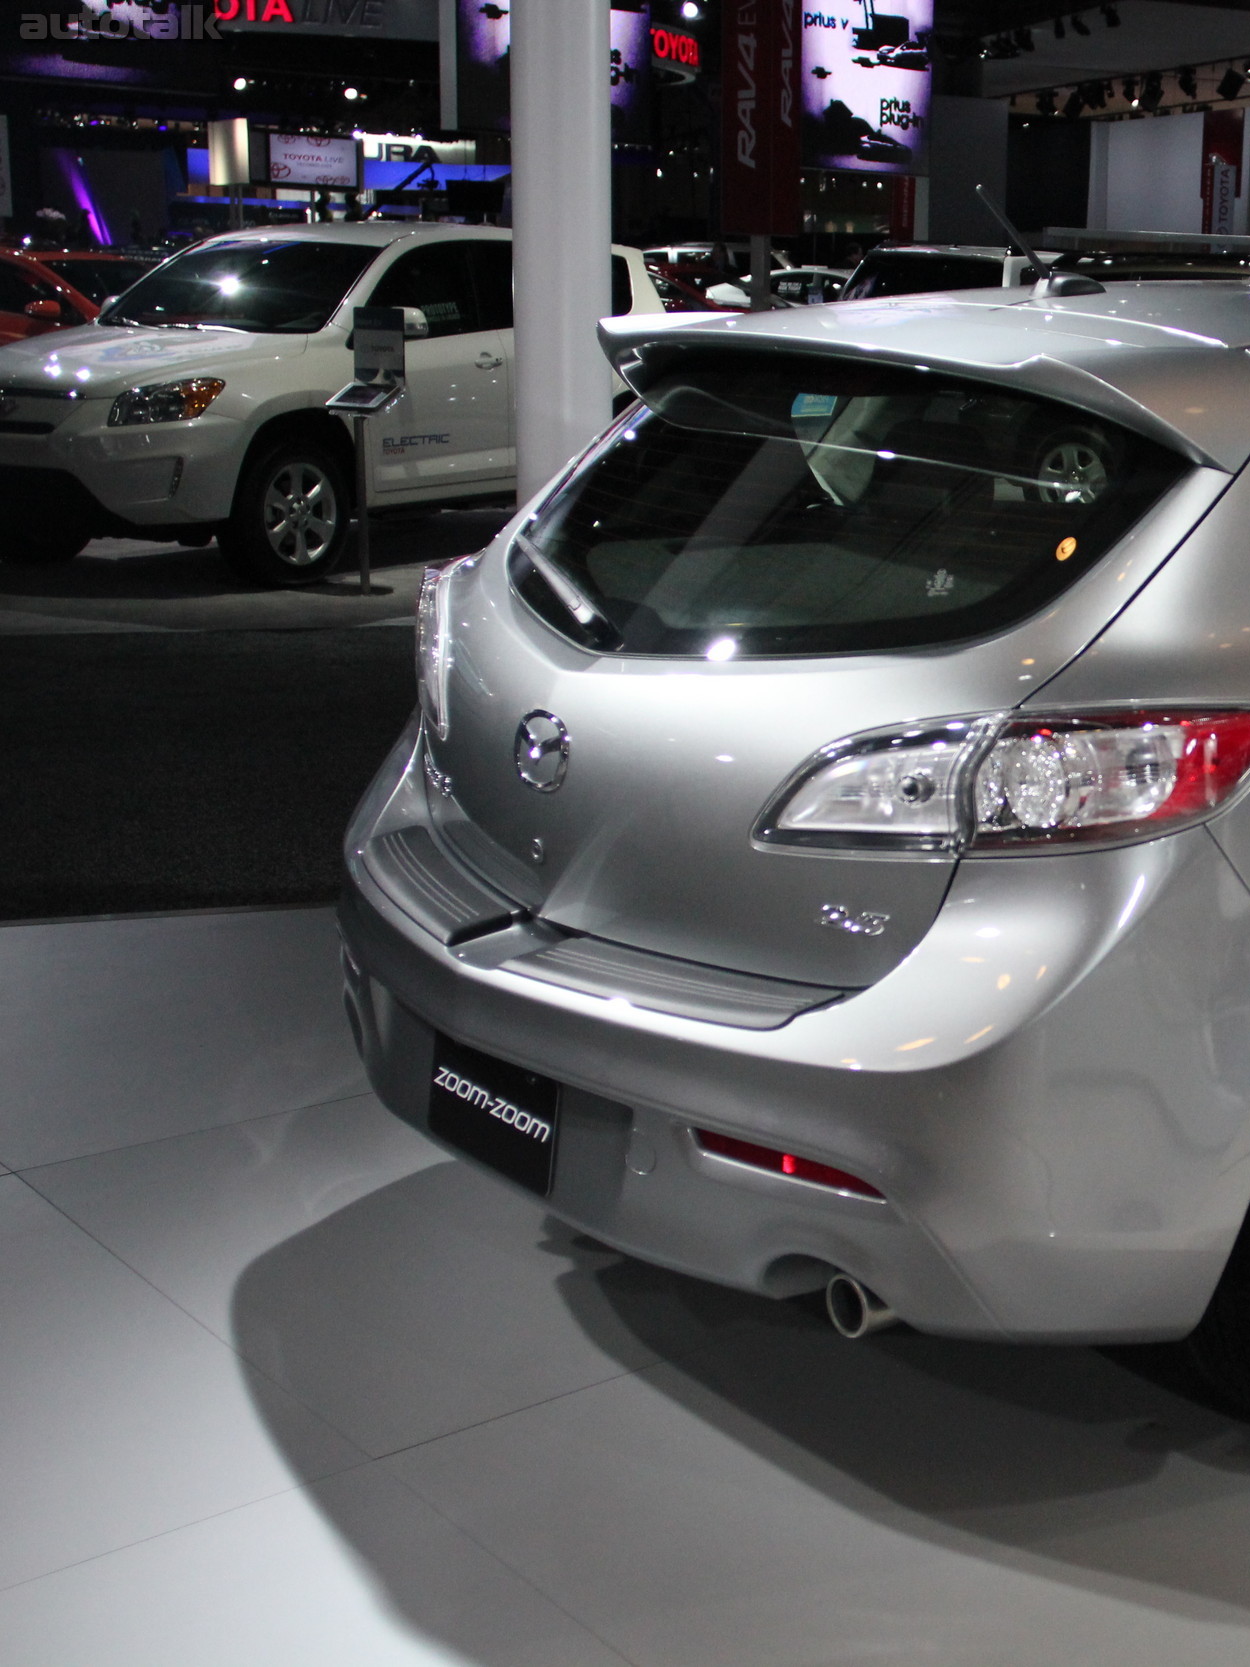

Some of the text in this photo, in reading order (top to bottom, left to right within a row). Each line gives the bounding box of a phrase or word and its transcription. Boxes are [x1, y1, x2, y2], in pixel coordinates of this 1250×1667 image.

[804, 11, 849, 30] prius v
[649, 28, 700, 67] OYOTA
[737, 33, 757, 169] RAV4
[284, 153, 345, 164] TOYOTA LIVE
[1218, 168, 1231, 223] TOYOTA
[382, 433, 450, 448] ELECTRIC
[433, 1066, 551, 1143] zoom-zoom
